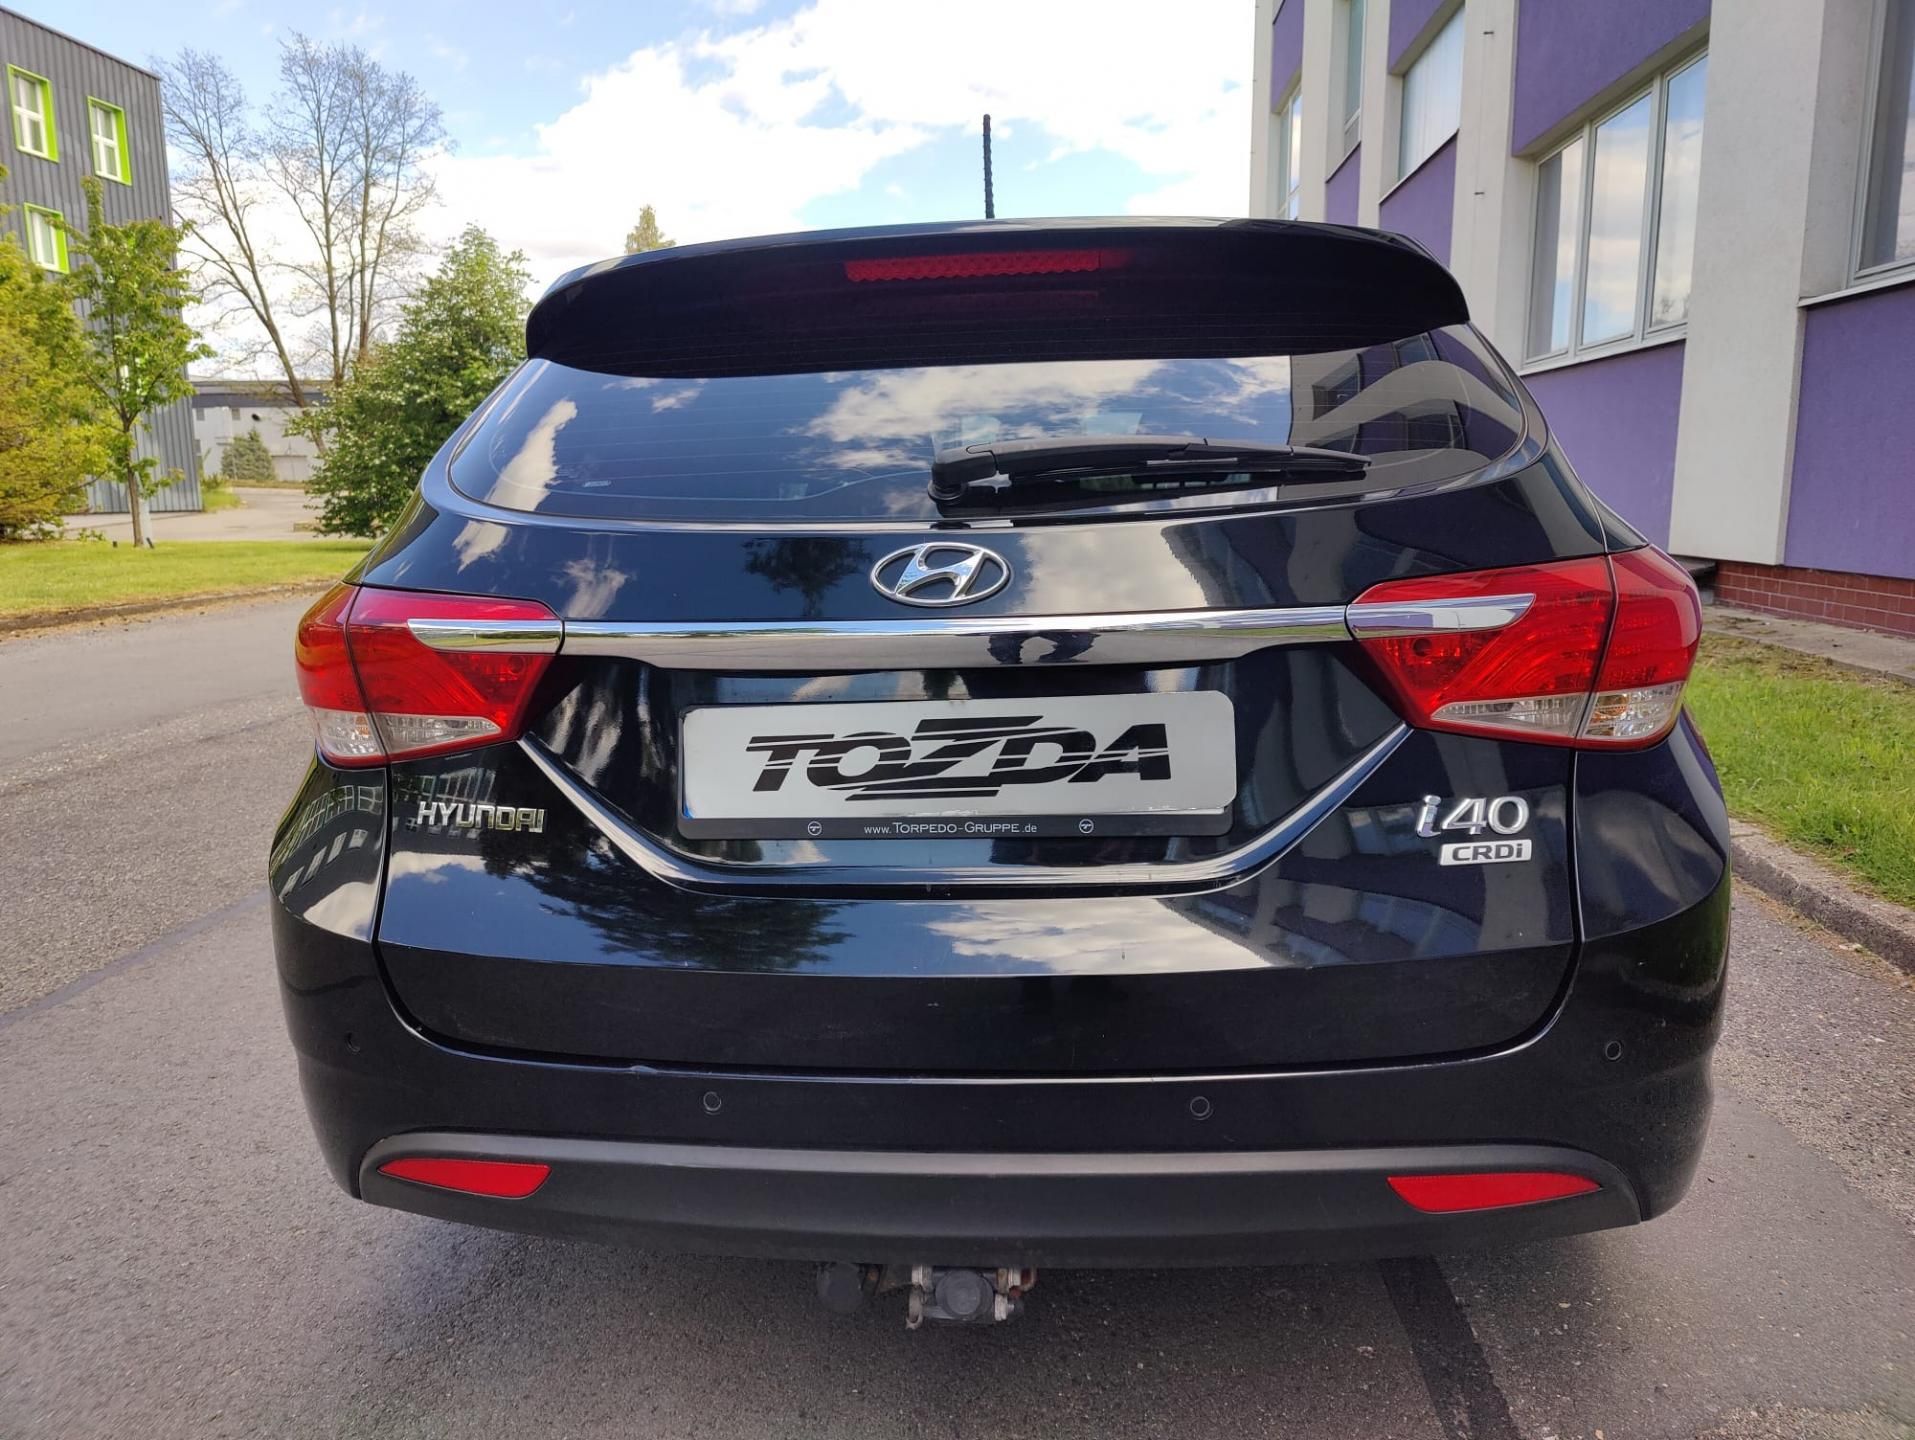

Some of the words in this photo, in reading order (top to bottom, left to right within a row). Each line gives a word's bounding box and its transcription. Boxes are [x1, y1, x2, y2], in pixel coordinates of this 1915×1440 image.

[746, 715, 1171, 801] TOZDA
[417, 801, 545, 833] HYUNDAI
[1416, 795, 1529, 838] i40
[1451, 843, 1524, 861] CRDi
